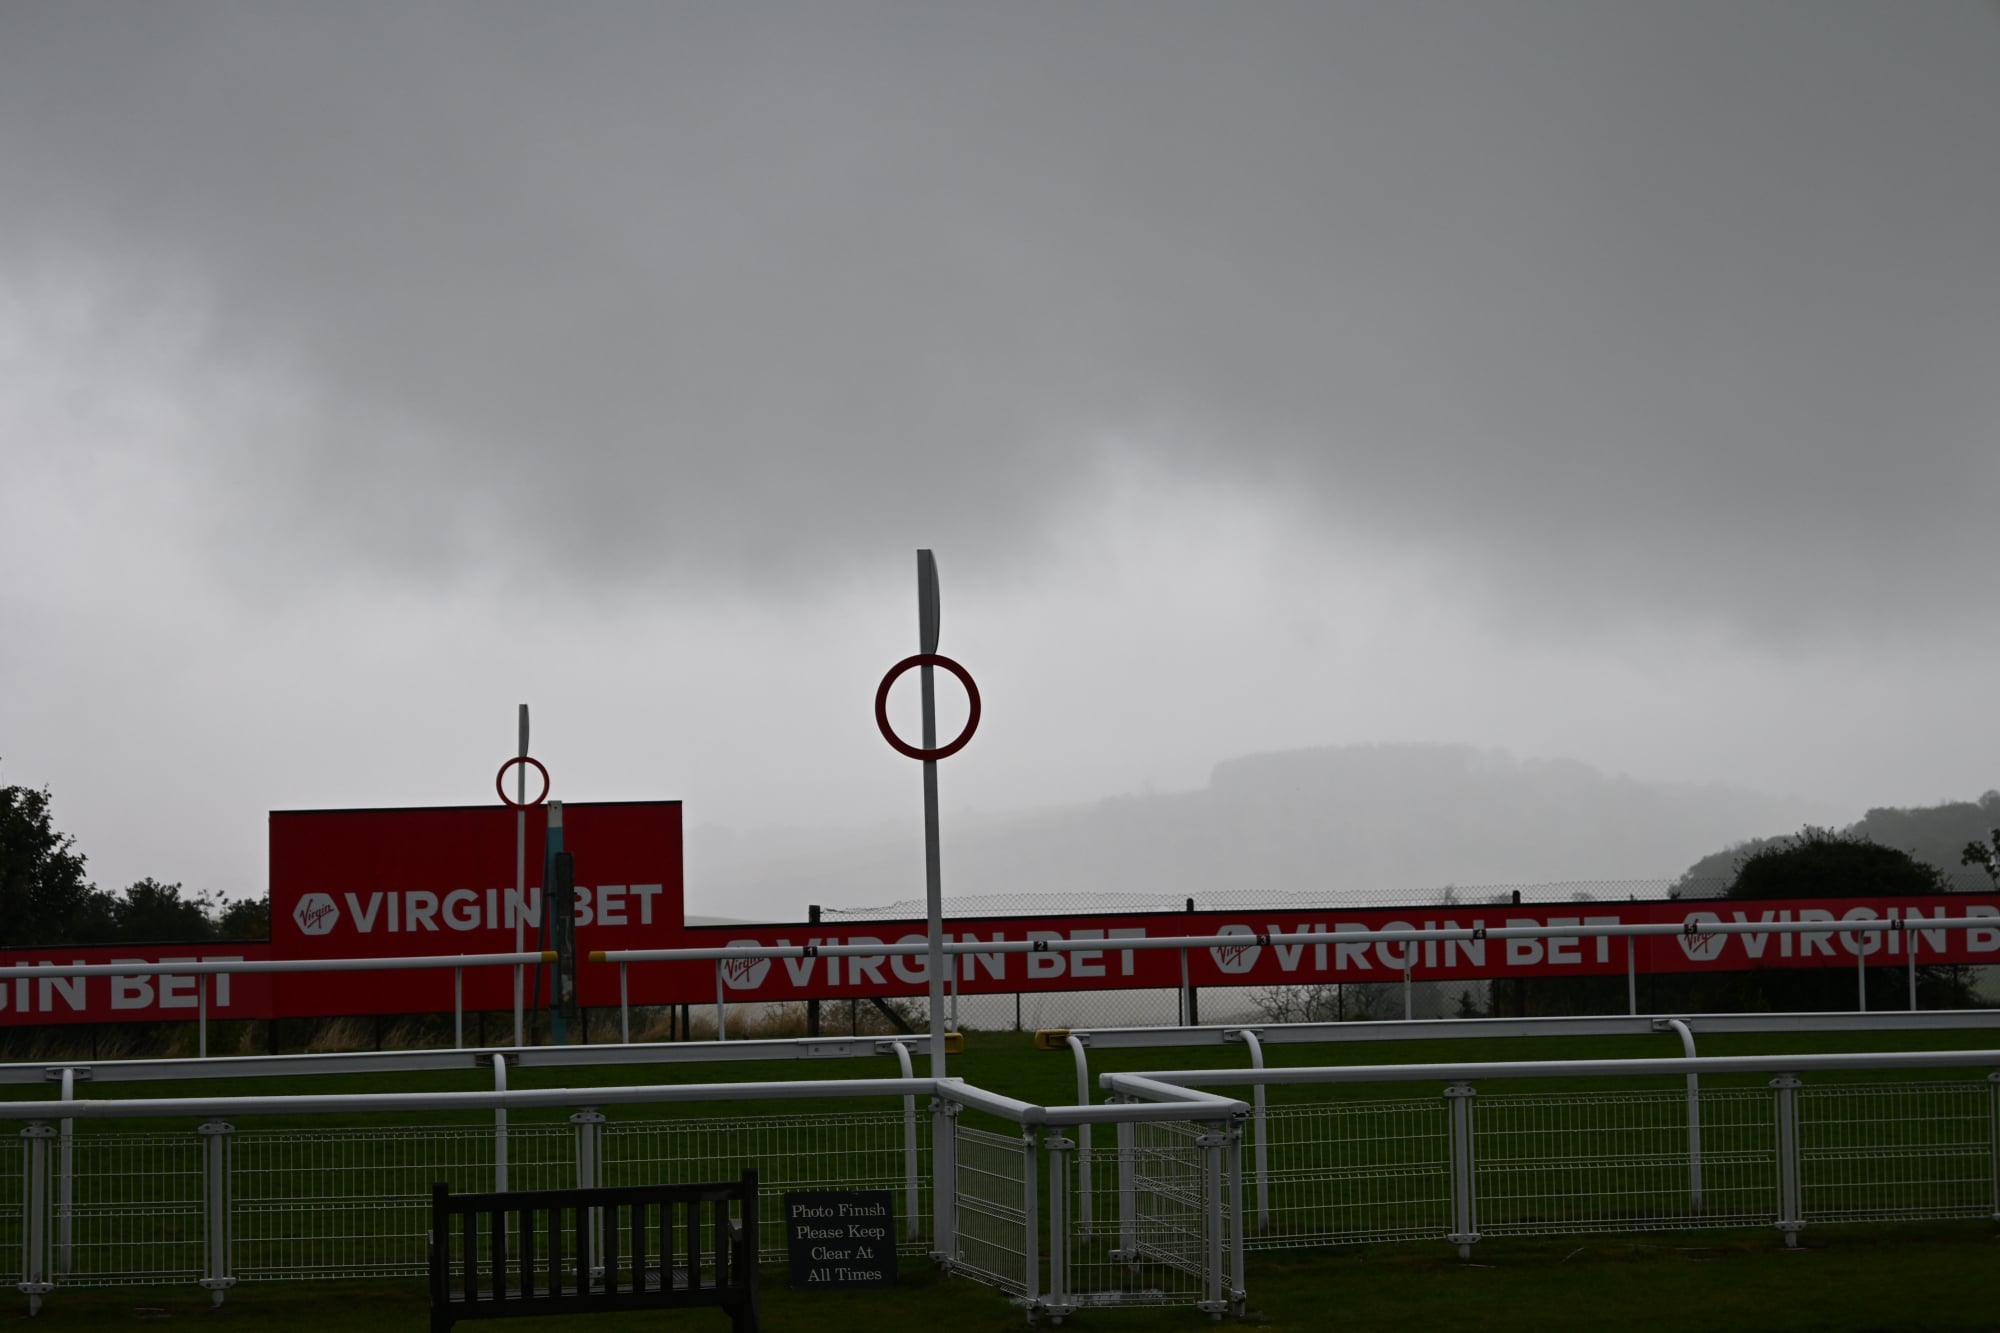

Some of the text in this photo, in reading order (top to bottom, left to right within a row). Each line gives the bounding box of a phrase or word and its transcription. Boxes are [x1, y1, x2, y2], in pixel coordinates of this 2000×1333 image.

[344, 887, 541, 933] VIRGIN
[1732, 906, 1946, 958] VIRGIN
[776, 928, 1146, 987] VIRGIN BET
[1266, 915, 1621, 972] VIRGIN BET
[111, 956, 244, 1010] BET
[792, 1203, 886, 1218] Photo Finish
[796, 1224, 886, 1240] Please Keep
[808, 1267, 883, 1282] All Times
[811, 1245, 874, 1260] Clear At
